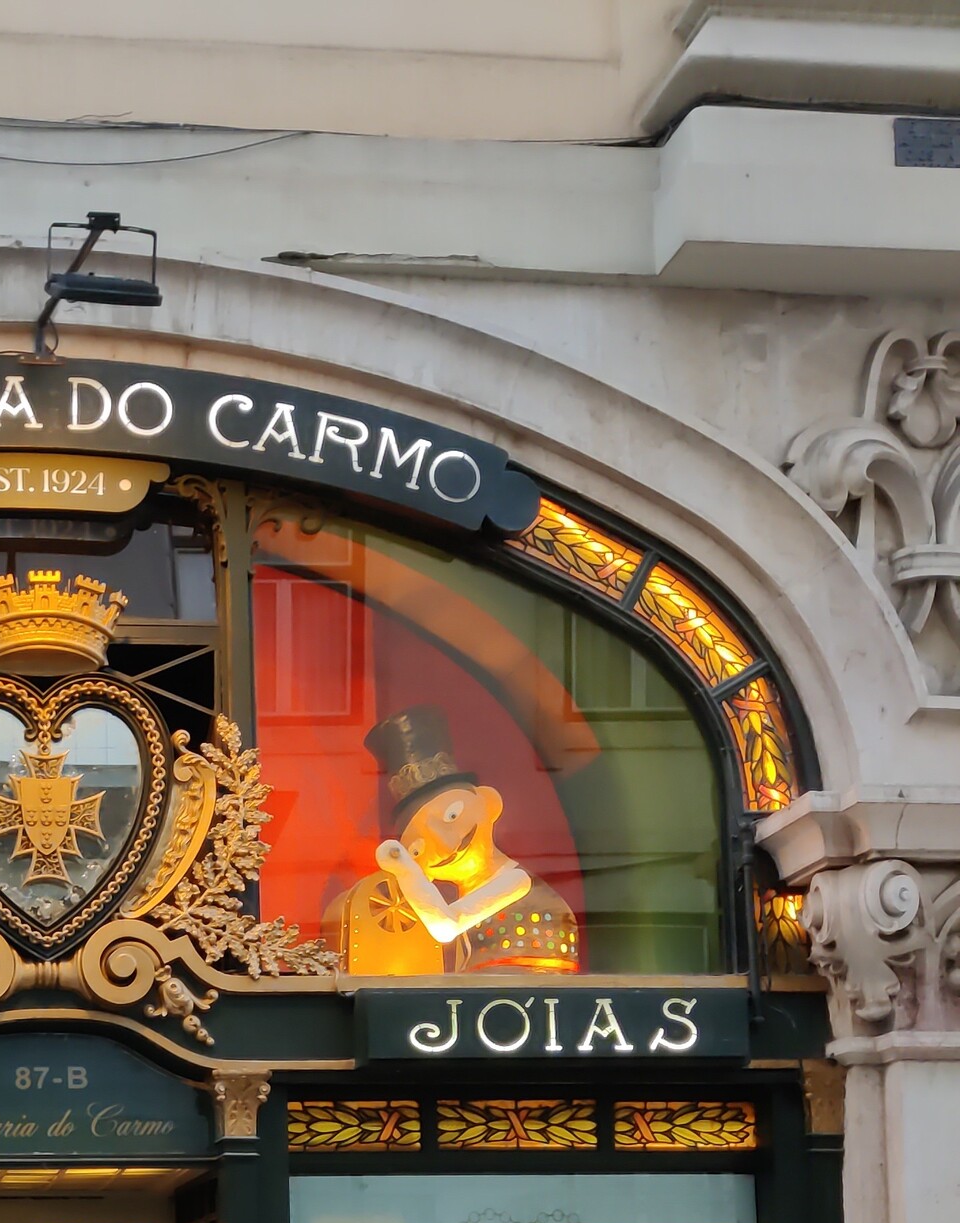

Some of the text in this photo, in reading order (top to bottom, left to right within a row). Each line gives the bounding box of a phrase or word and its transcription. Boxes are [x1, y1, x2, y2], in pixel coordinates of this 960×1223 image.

[66, 376, 173, 436] DO
[207, 393, 481, 503] CARMO
[42, 468, 106, 496] 1924
[409, 996, 699, 1052] JÓIAS
[15, 1066, 89, 1090] 87-B
[46, 1109, 76, 1138] do
[86, 1102, 176, 1138] Carmo
